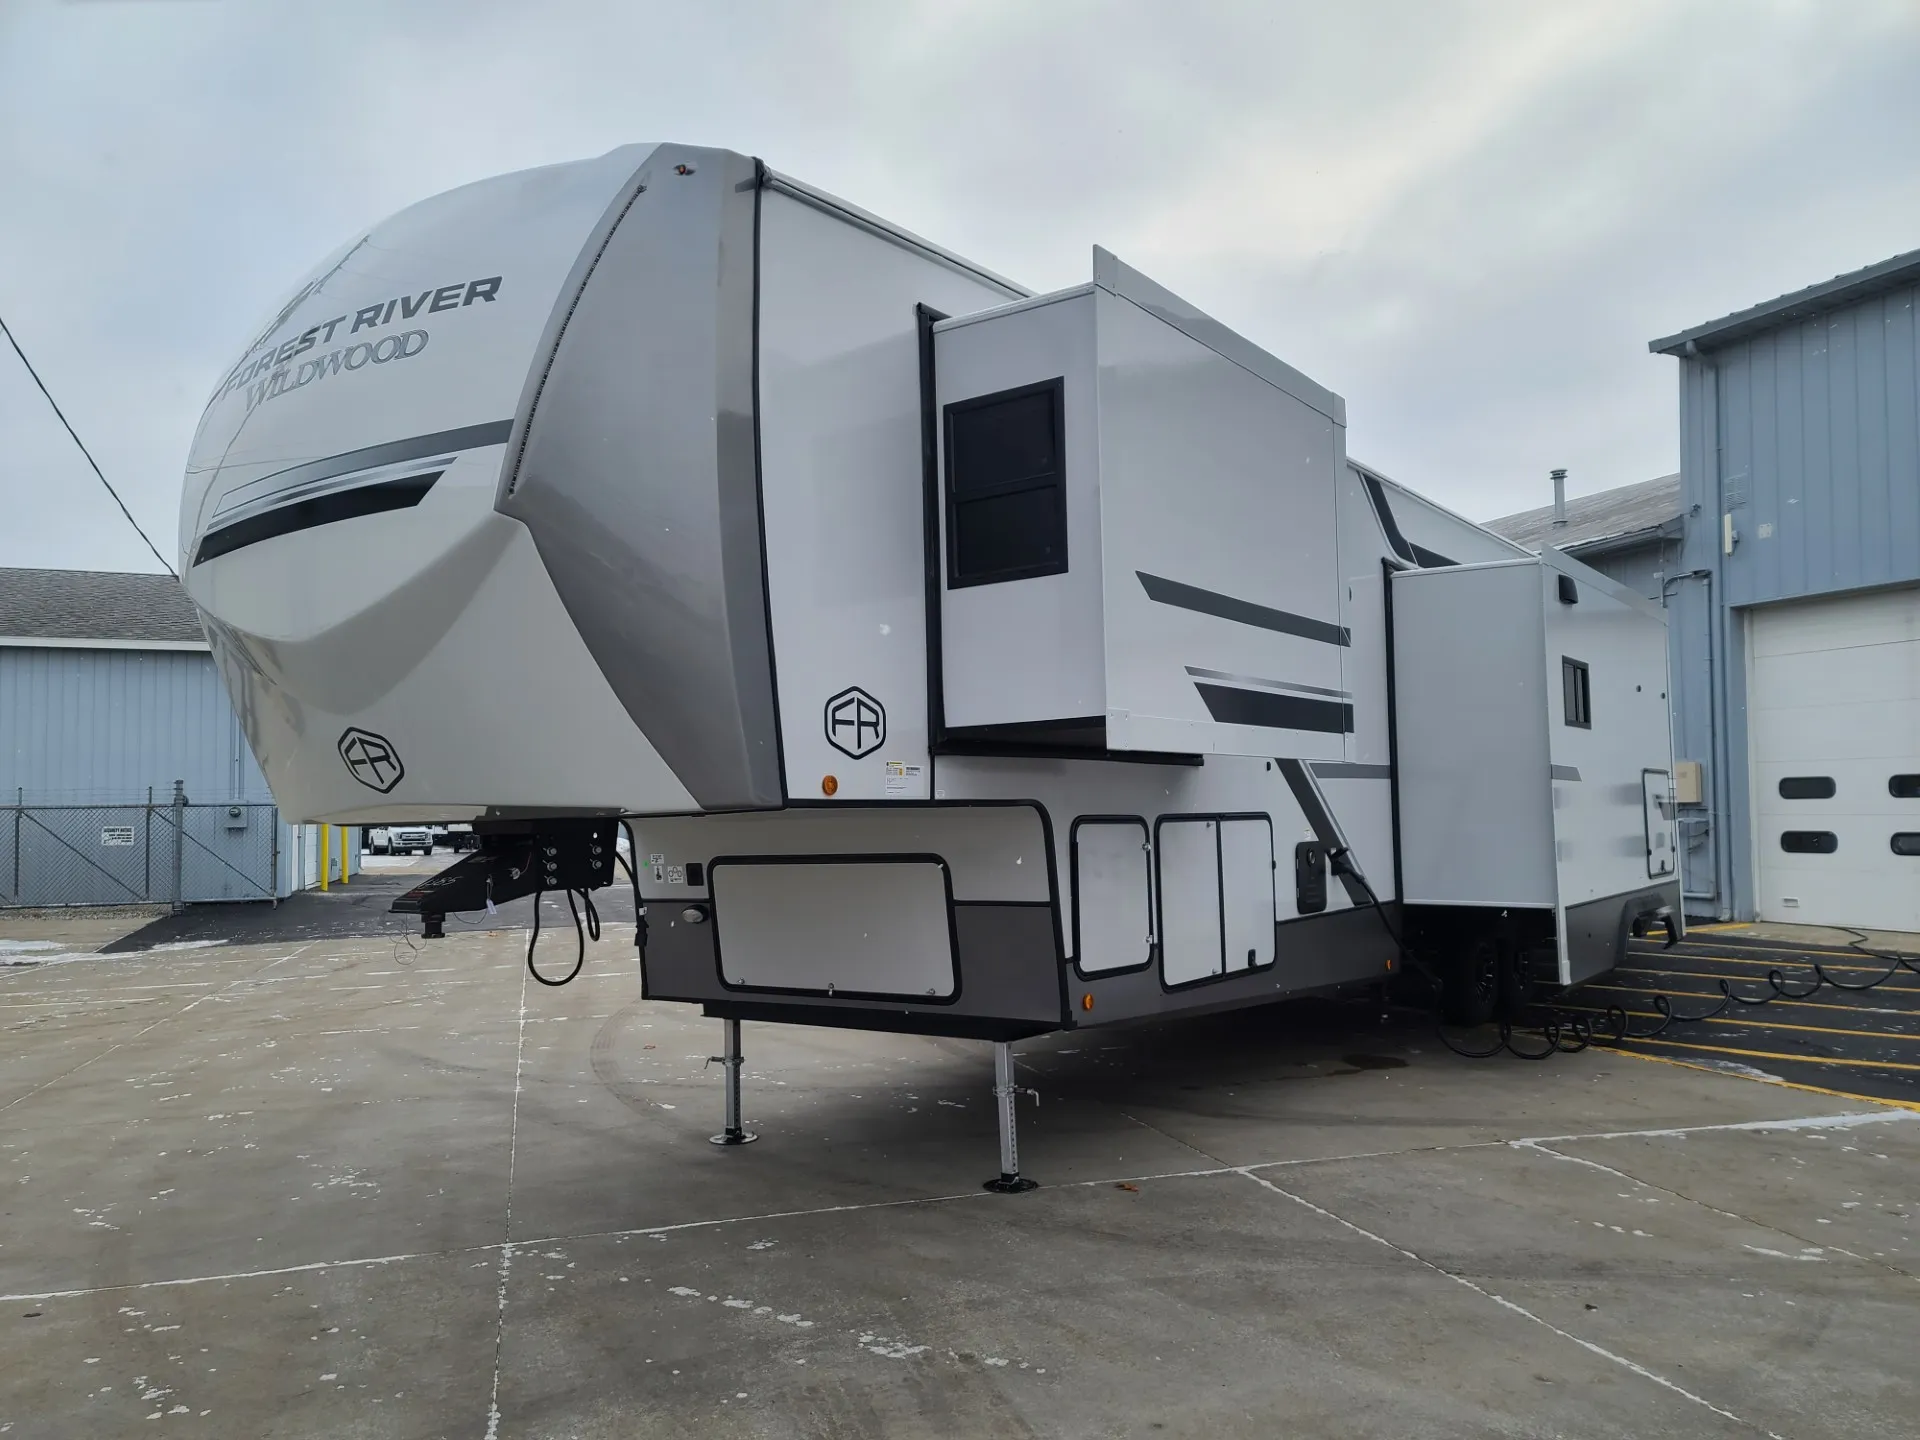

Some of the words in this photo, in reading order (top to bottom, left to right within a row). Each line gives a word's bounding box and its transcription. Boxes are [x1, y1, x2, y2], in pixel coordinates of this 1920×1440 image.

[222, 315, 347, 400] FOREST
[351, 276, 503, 334] RIVER
[246, 328, 430, 411] WILDWOOD
[831, 696, 880, 750] FR
